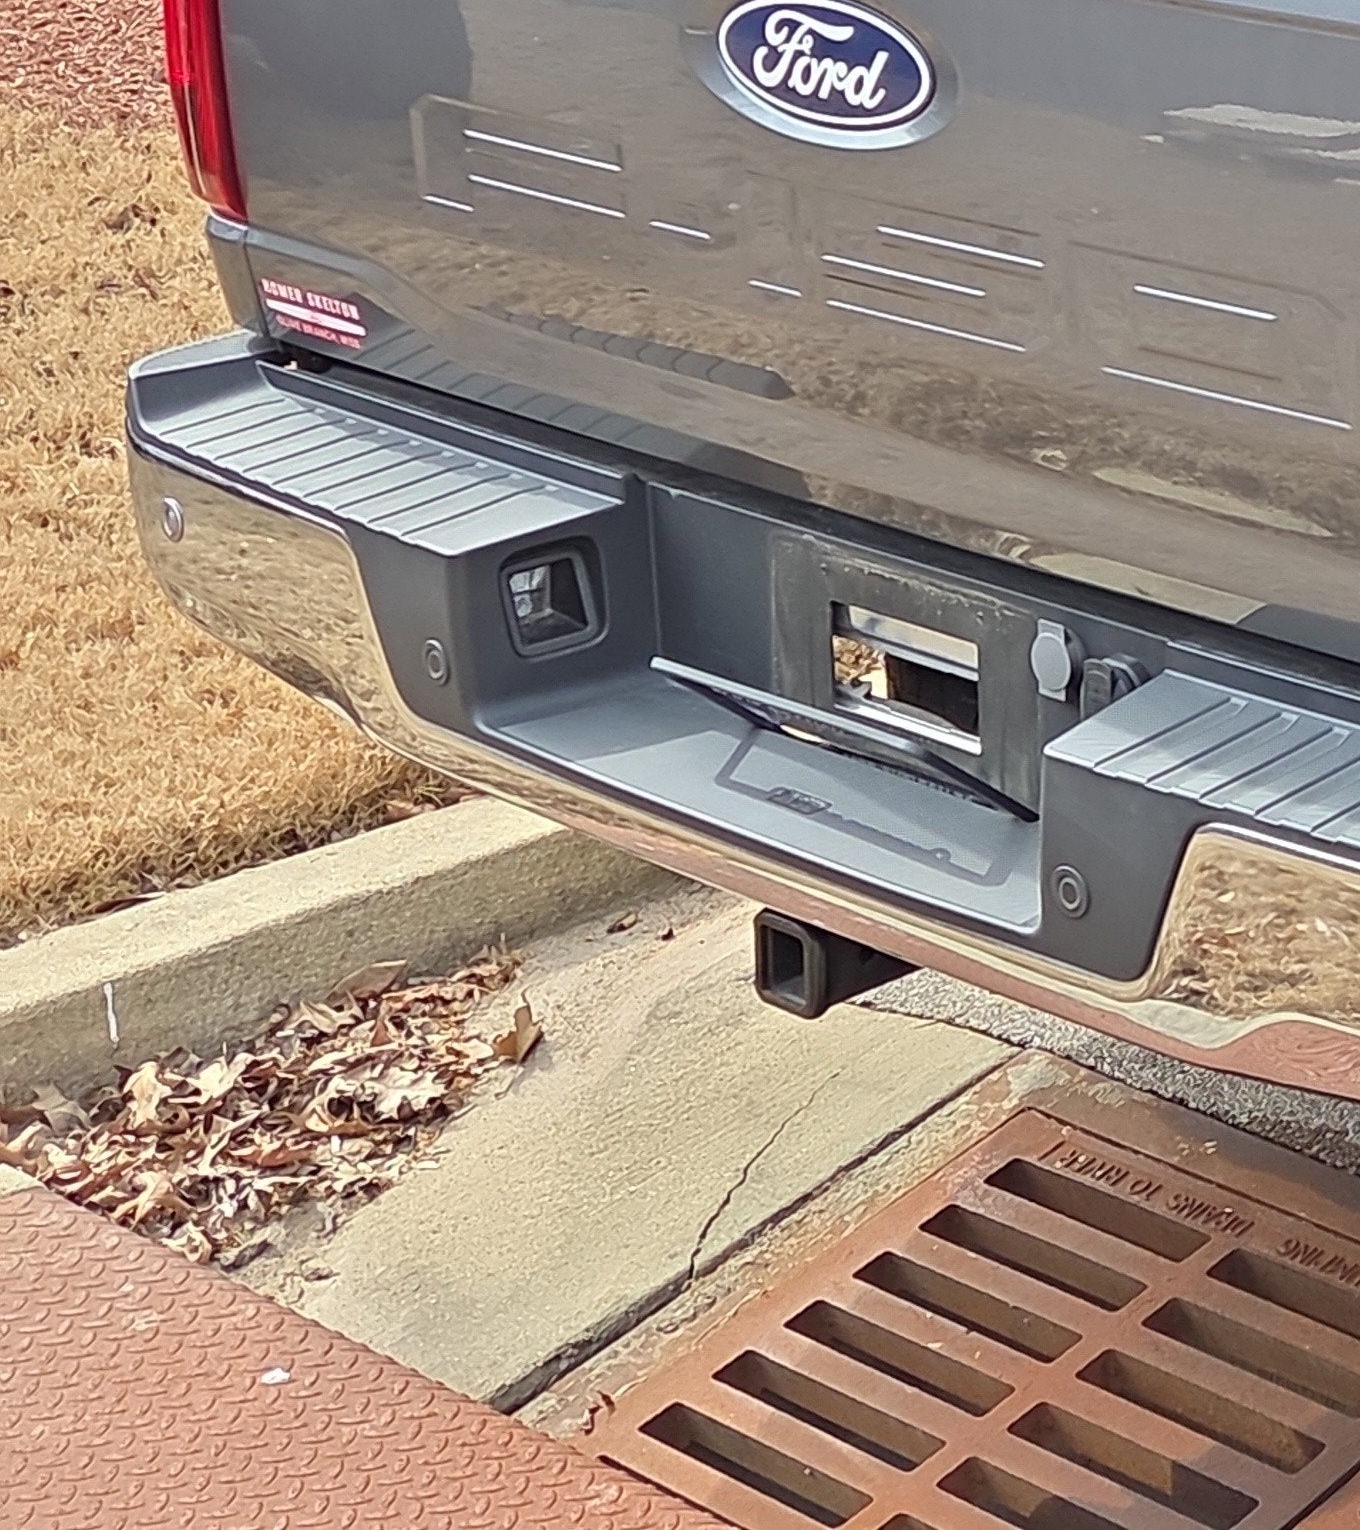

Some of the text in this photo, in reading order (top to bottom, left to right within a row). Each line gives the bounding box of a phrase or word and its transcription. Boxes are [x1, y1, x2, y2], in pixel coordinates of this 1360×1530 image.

[753, 8, 889, 110] Ford
[1128, 1179, 1163, 1202] TO
[1166, 1192, 1256, 1238] DRAINS
